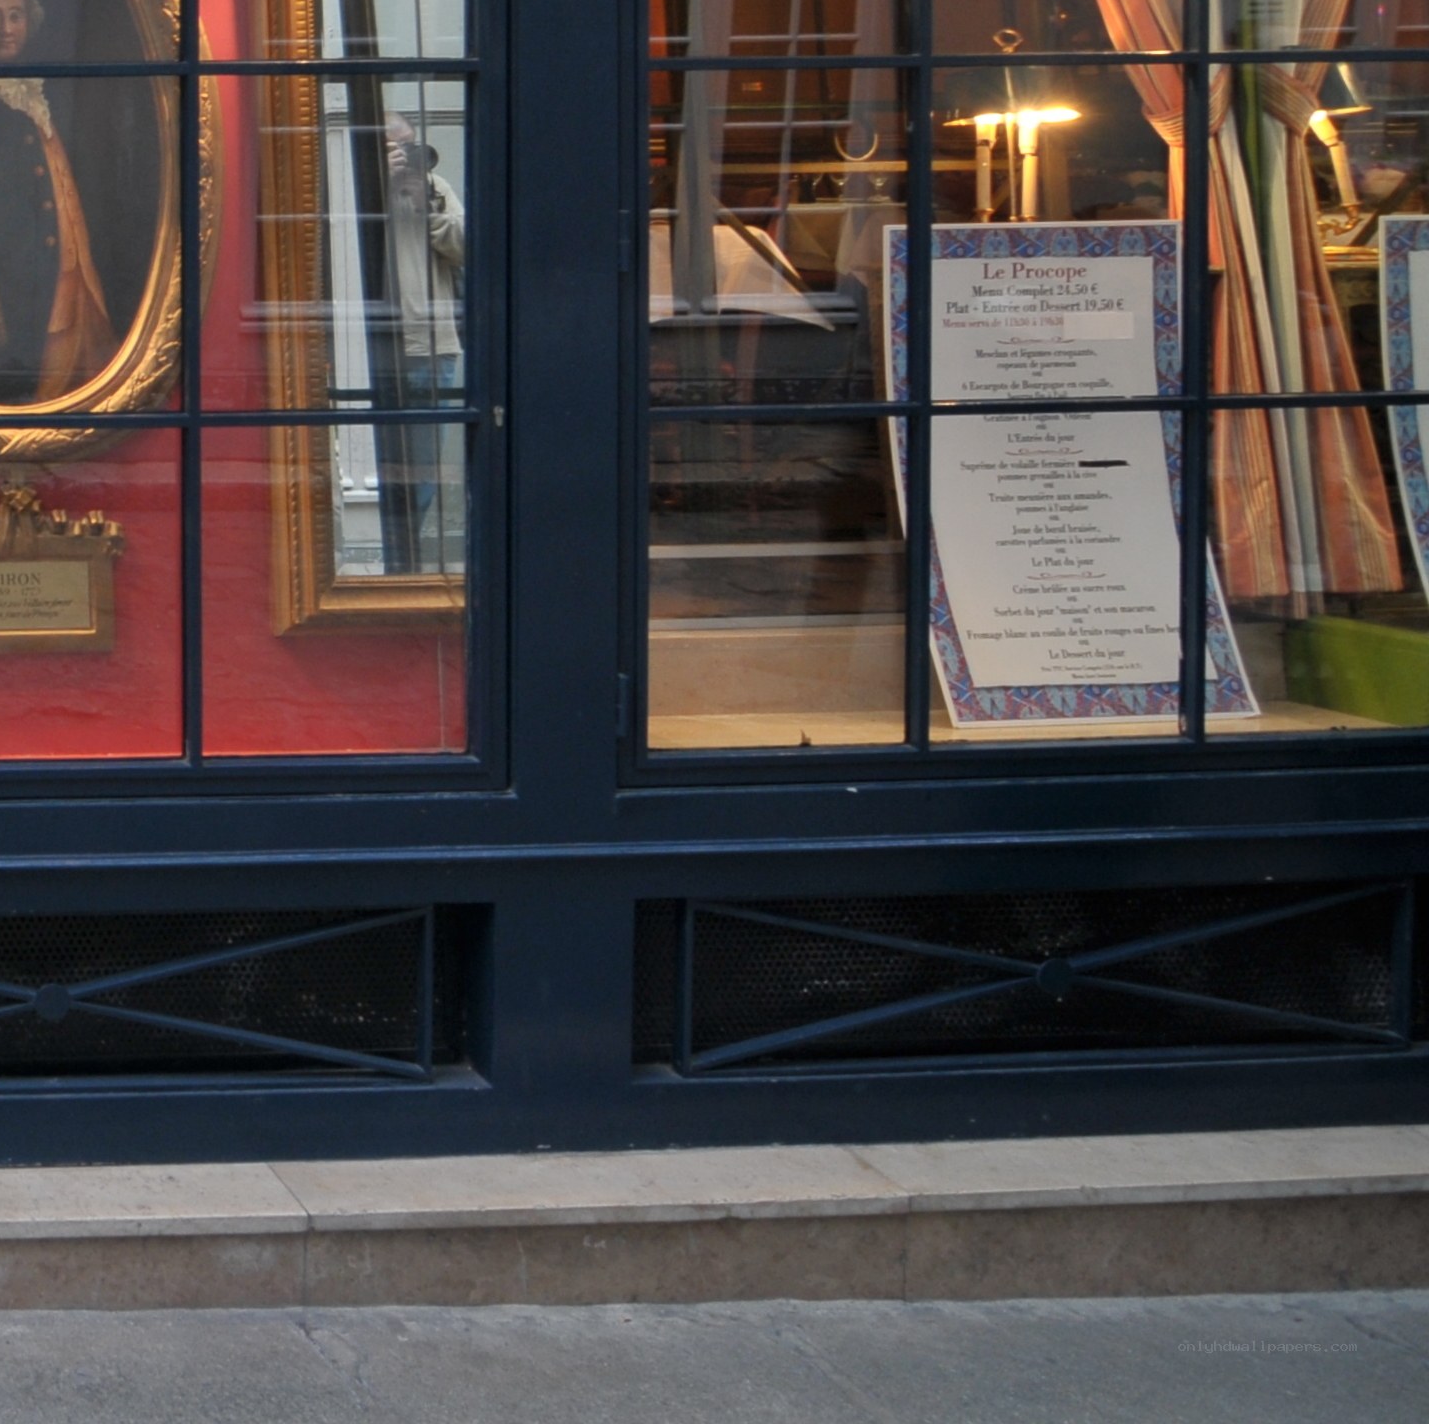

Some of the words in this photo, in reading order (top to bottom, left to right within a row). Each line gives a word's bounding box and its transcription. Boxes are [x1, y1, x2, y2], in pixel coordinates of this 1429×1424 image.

[983, 263, 1005, 280] Le
[1011, 262, 1087, 282] Procope
[972, 285, 1003, 297] Menu
[1007, 285, 1054, 298] Complet
[1091, 284, 1098, 294] €
[946, 303, 968, 314] Plat
[983, 301, 1019, 313] Entrée
[1023, 303, 1036, 312] ou
[1040, 300, 1080, 312] Dessert
[1117, 299, 1124, 310] €
[1010, 381, 1020, 389] de
[1031, 558, 1042, 567] Le
[1045, 557, 1062, 567] Plat
[1064, 557, 1075, 566] du
[1049, 650, 1058, 659] Le
[1061, 649, 1092, 659] Dessert
